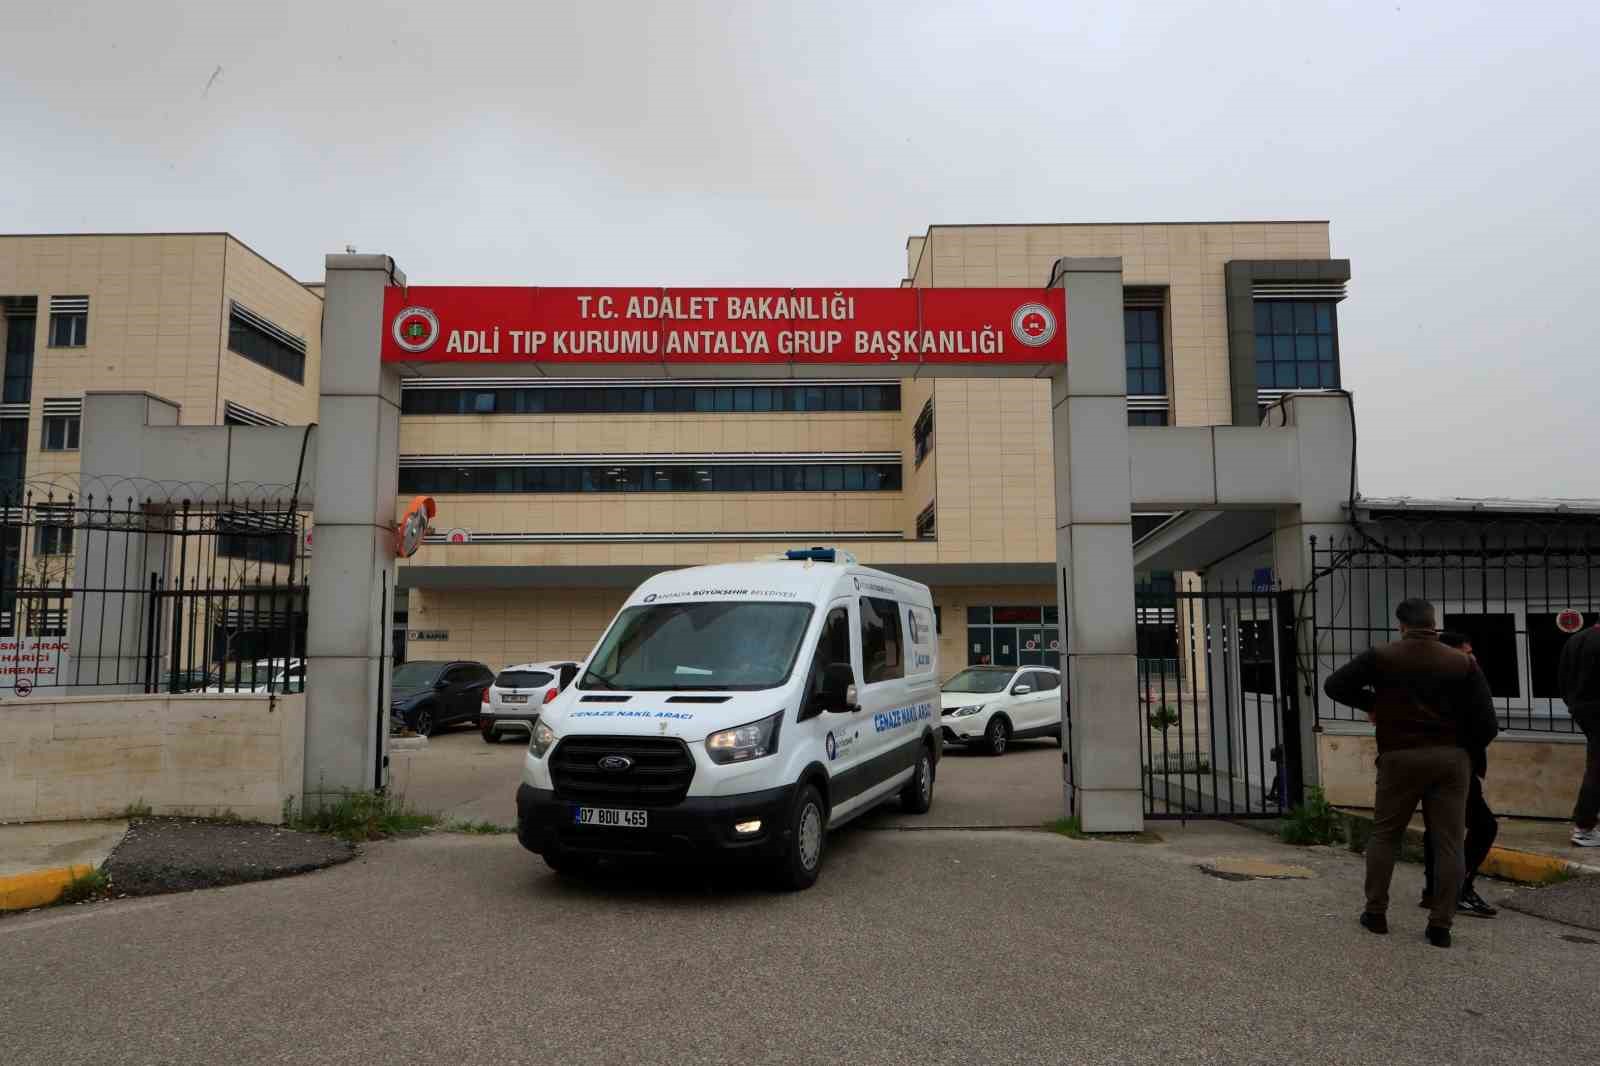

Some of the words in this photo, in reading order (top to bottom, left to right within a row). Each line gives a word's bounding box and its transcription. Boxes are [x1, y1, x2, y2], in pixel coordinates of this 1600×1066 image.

[577, 296, 619, 319] T.C.
[626, 296, 719, 319] ADALET
[727, 290, 855, 320] BAKANLIĞI
[446, 326, 500, 354] ADLİ
[508, 331, 547, 354] TIP
[553, 331, 658, 354] KURUMU
[665, 331, 770, 354] ANTALYA
[777, 331, 842, 354] GRUP
[855, 324, 1004, 361] BAŞKANLIĞI
[581, 808, 594, 823] 07
[625, 811, 646, 826] 465
